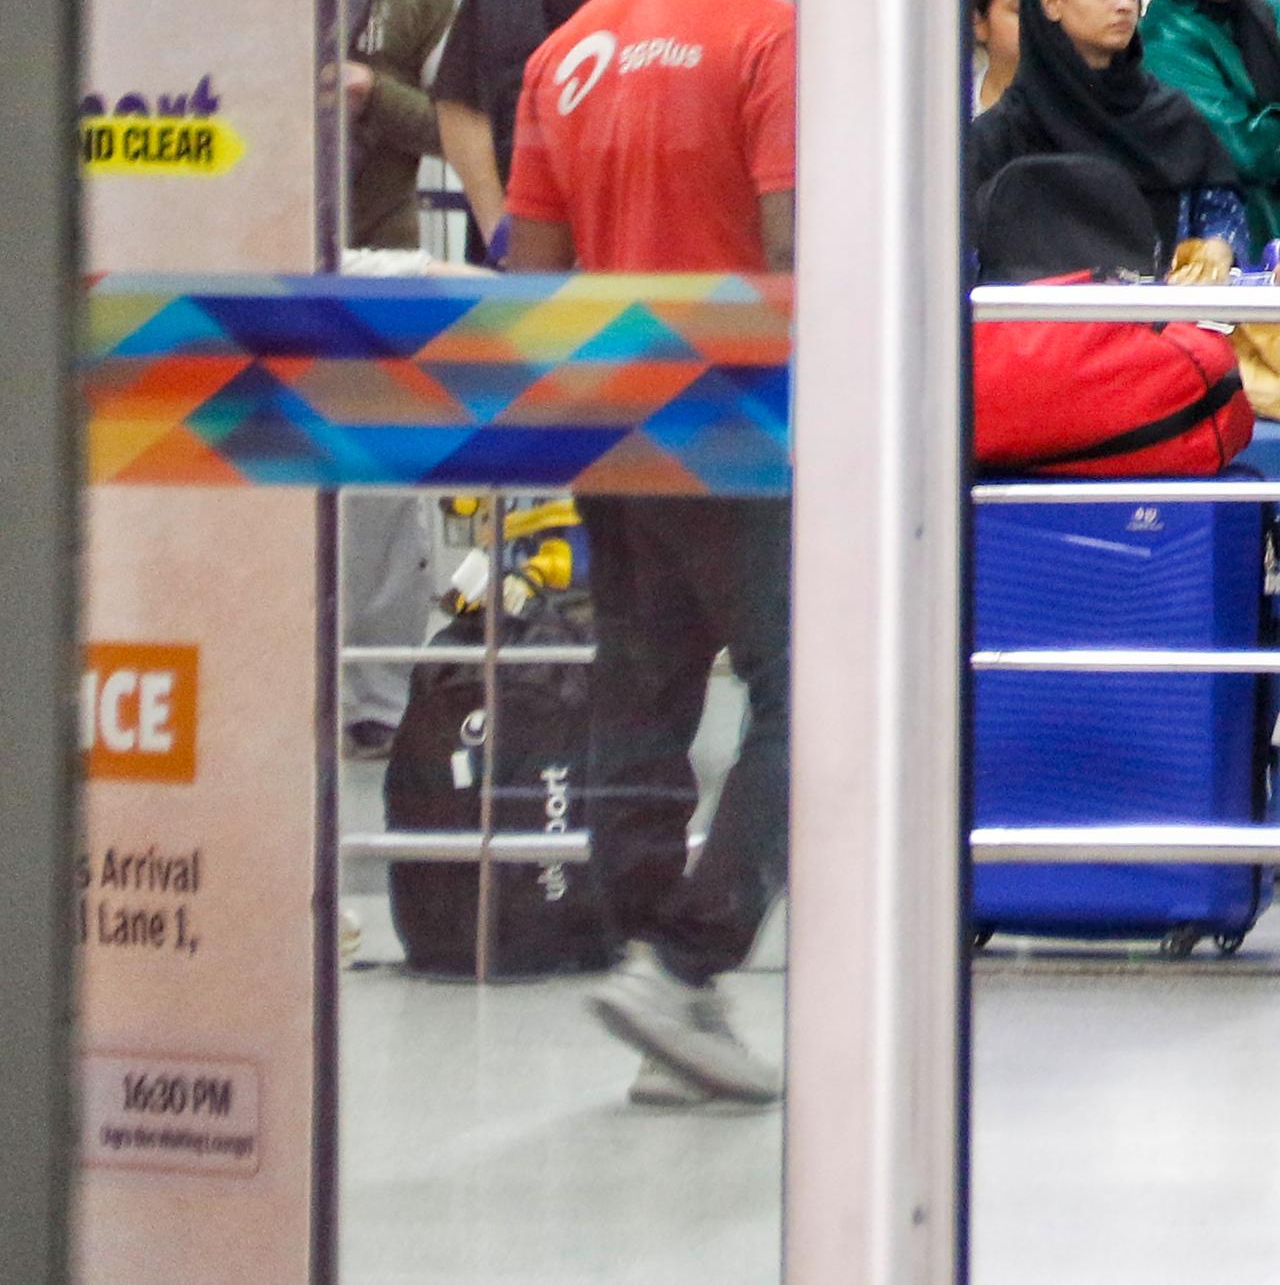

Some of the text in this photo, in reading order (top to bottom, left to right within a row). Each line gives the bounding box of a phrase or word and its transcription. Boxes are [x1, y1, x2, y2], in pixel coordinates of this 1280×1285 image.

[123, 125, 214, 163] CLEAR
[81, 670, 174, 753] ICE
[101, 846, 199, 893] Arrival
[98, 901, 166, 948] Lane
[174, 905, 198, 954] 1,
[192, 1075, 232, 1118] PM
